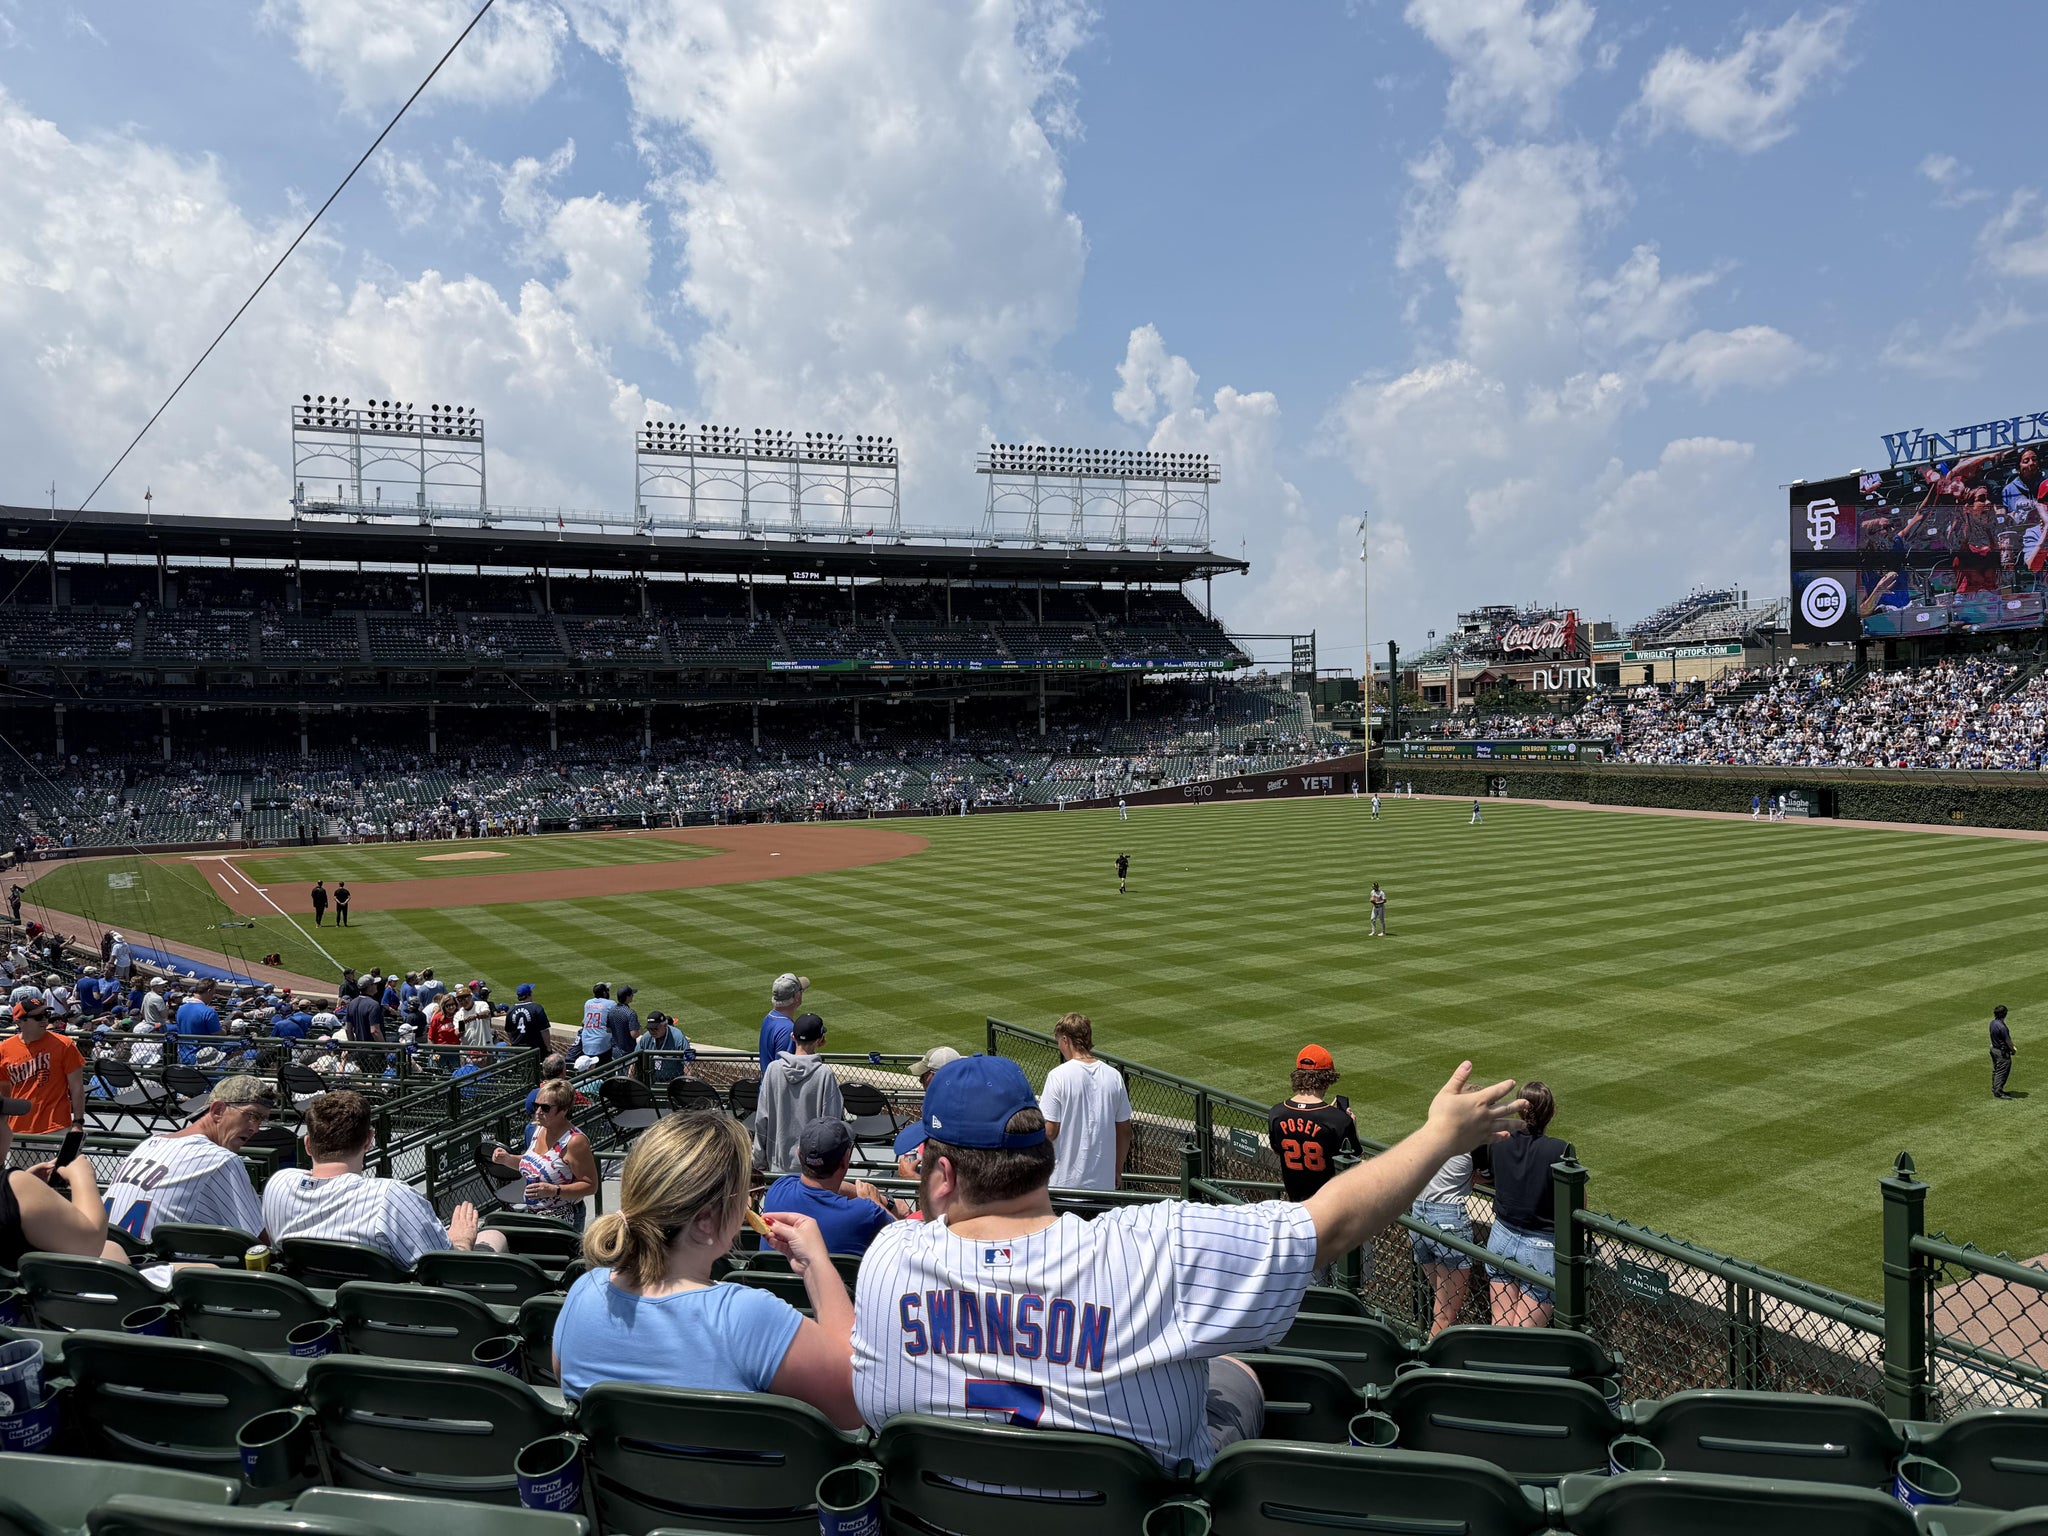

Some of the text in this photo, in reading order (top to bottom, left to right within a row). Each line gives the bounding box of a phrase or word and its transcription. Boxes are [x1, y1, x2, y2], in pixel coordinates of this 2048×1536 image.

[1502, 619, 1568, 652] Coca-Cola
[1636, 646, 1728, 660] WRIGLEYOOFTOPS.COM
[1183, 785, 1213, 797] eero
[1301, 776, 1333, 790] YETI
[517, 1016, 526, 1034] 4
[584, 1012, 602, 1029] 23
[1280, 1118, 1322, 1138] POSEY
[460, 1142, 470, 1154] 134
[1233, 1141, 1257, 1154] STANDING
[1240, 1137, 1249, 1145] NO
[1281, 1138, 1327, 1172] 28
[112, 1158, 169, 1192] IZZO
[1622, 1274, 1664, 1295] STANDING
[899, 1289, 1112, 1373] SWANSON
[11, 1426, 37, 1438] Hefty
[25, 1430, 51, 1446] Hefty
[533, 1481, 561, 1492] Hefty
[547, 1486, 572, 1502] Hefty
[840, 1518, 867, 1530] Hefty
